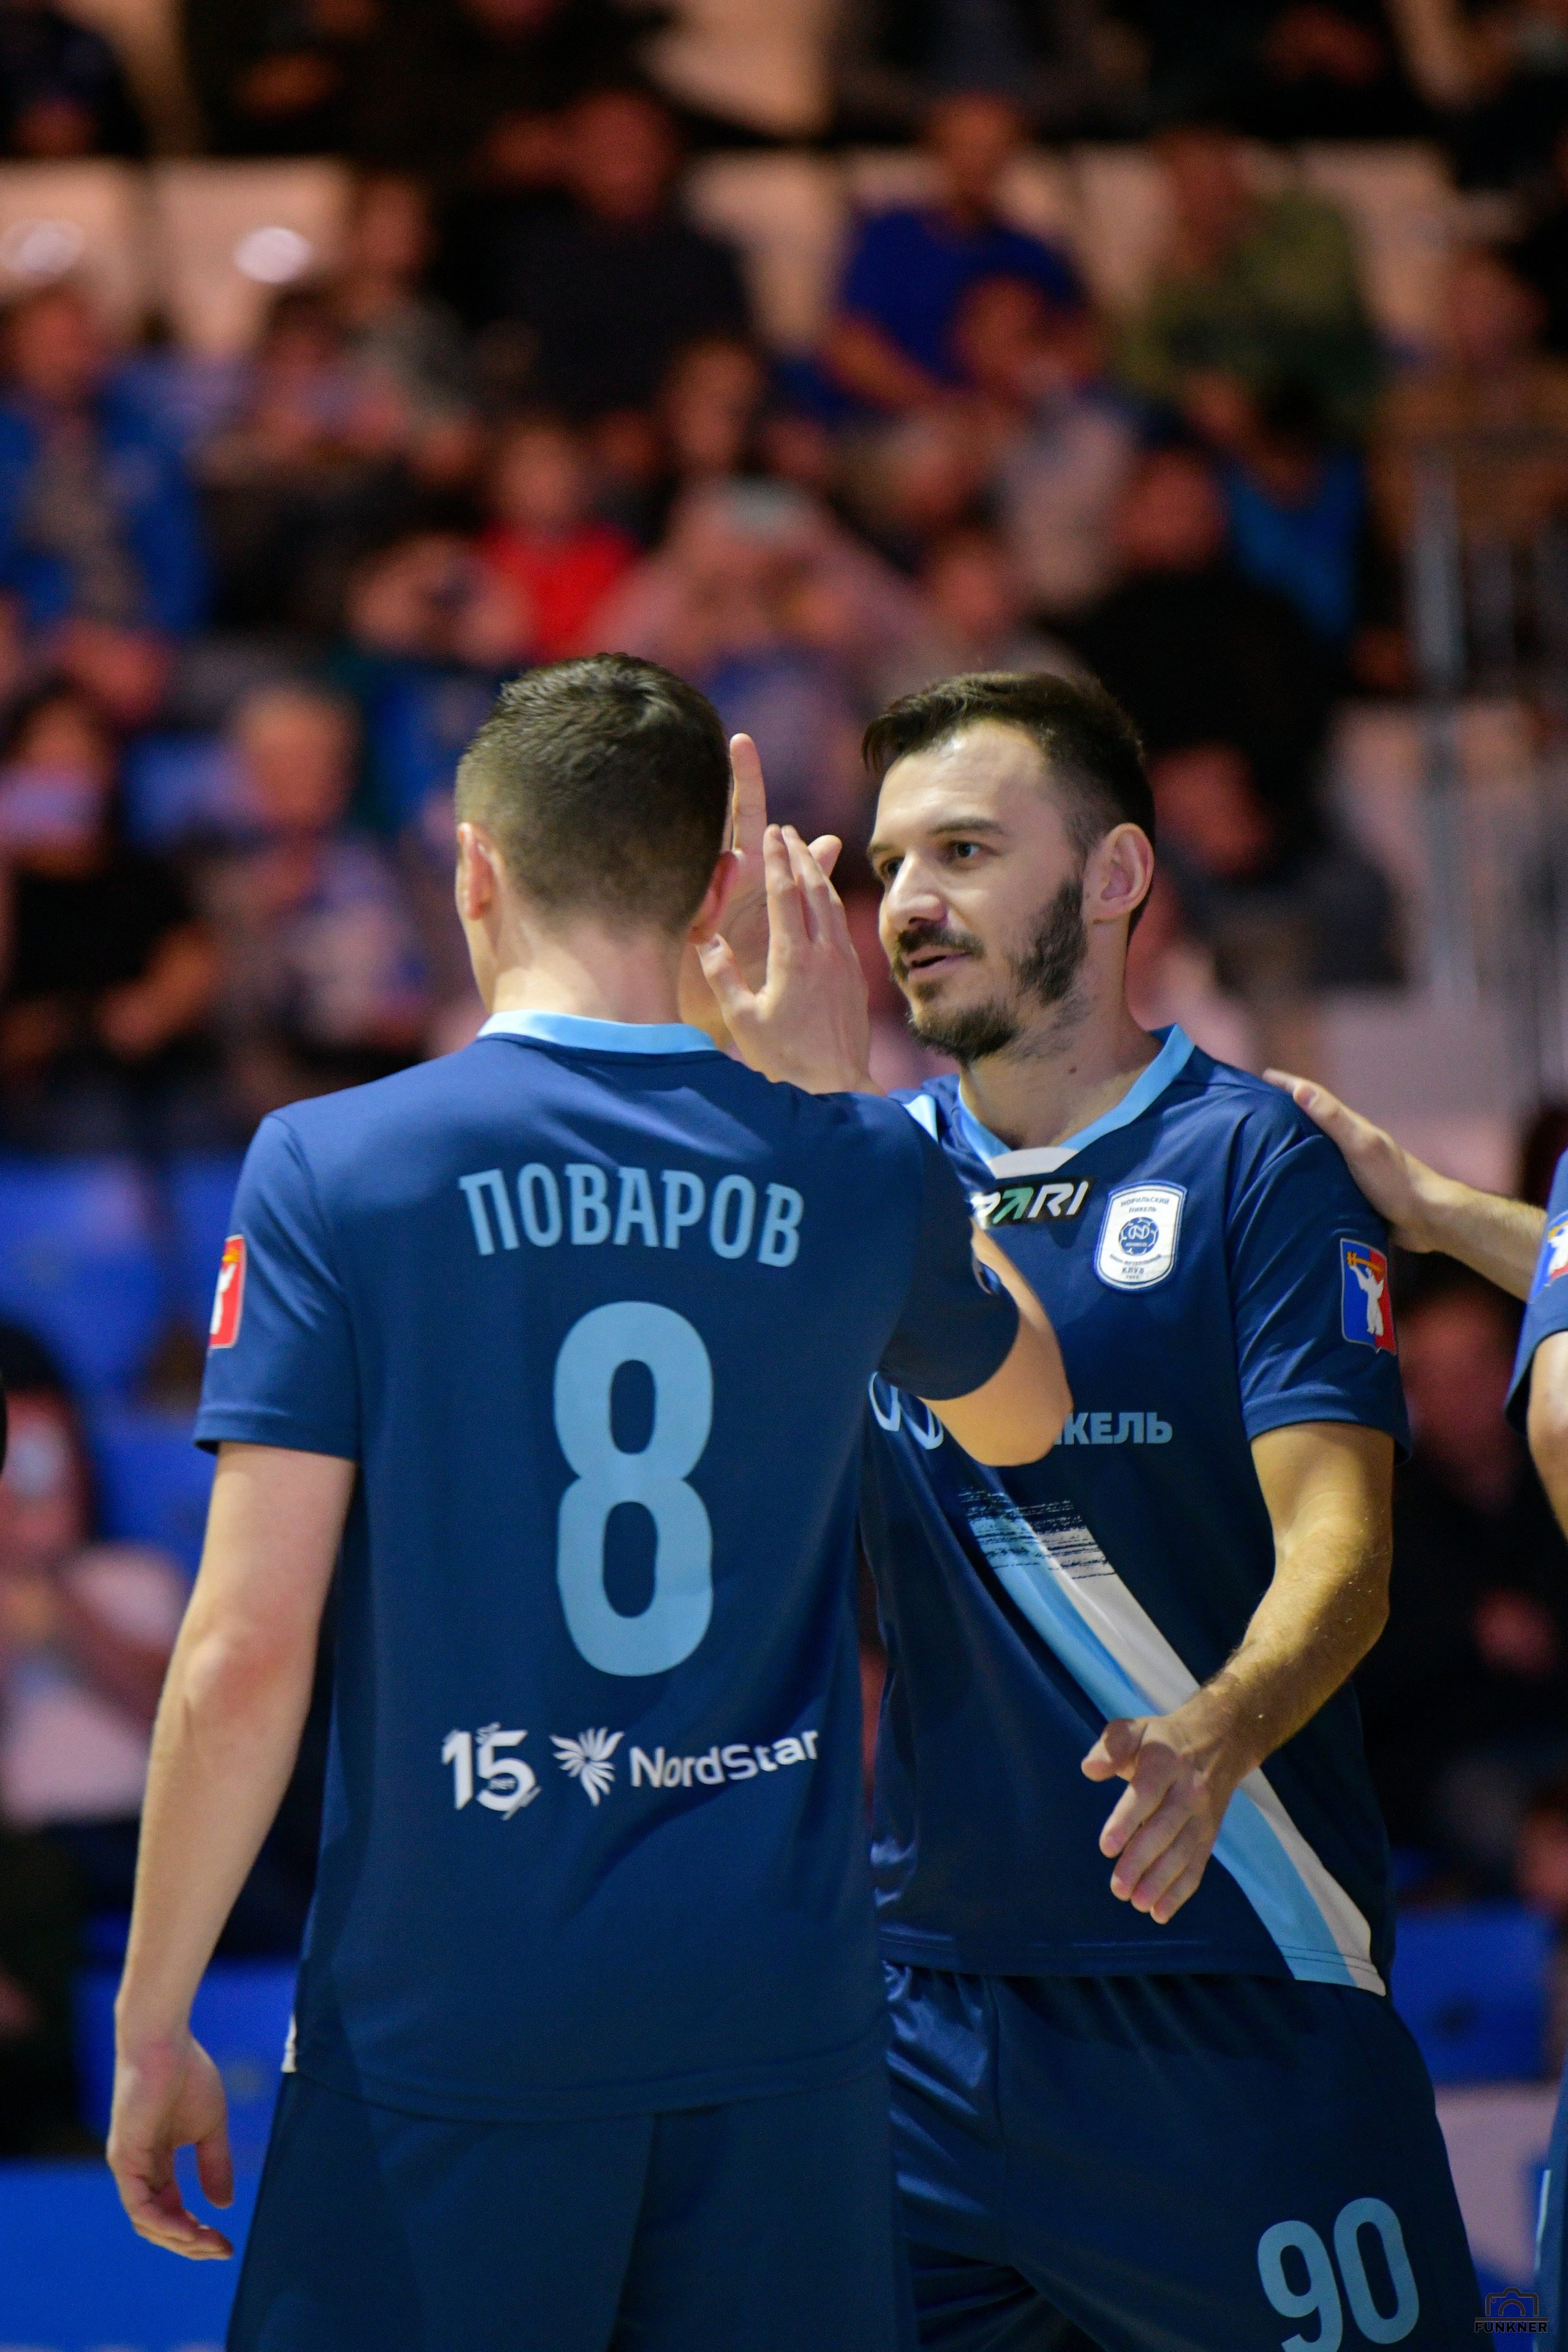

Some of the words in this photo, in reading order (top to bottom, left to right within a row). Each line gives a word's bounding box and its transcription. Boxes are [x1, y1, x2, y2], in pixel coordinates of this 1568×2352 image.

[458, 1163, 804, 1268] ПОВАРОВ
[1054, 1411, 1173, 1446] КЕЛЬ
[554, 1300, 714, 1677] 8
[442, 1722, 542, 1821] 15
[629, 1730, 820, 1789] NordStar
[1257, 2197, 1420, 2352] 90
